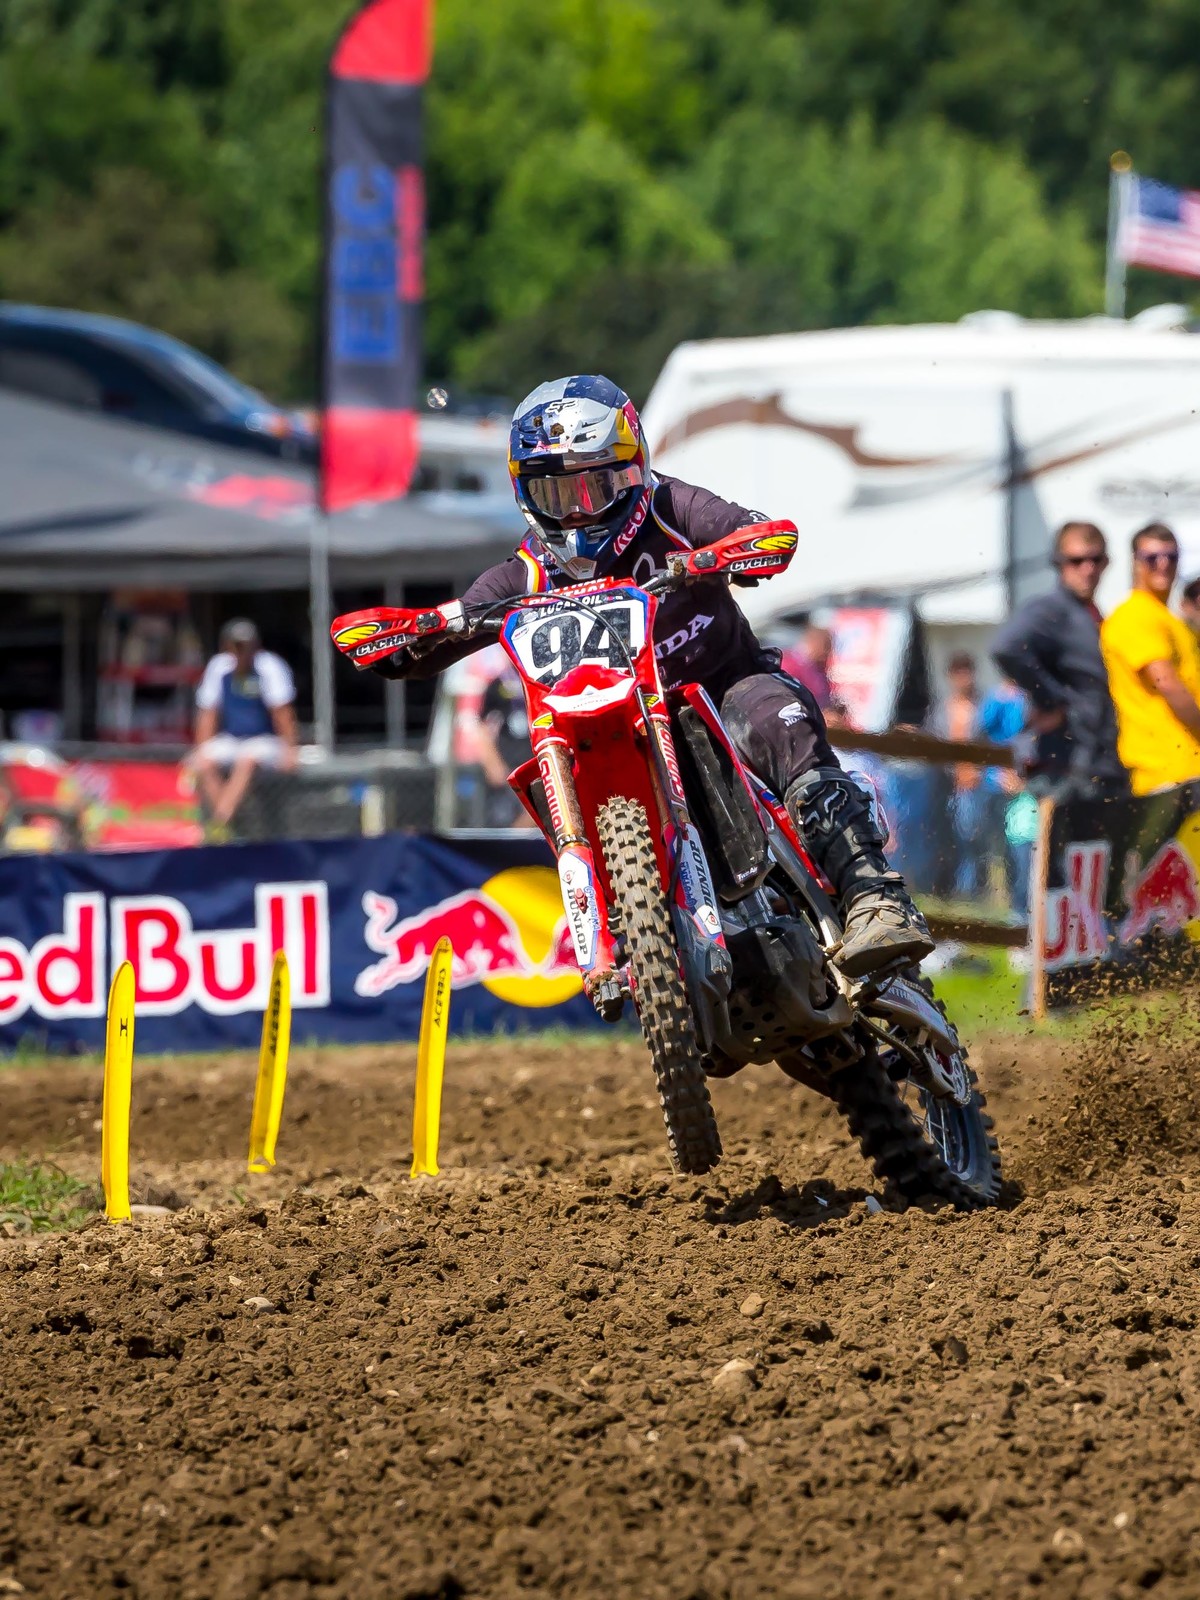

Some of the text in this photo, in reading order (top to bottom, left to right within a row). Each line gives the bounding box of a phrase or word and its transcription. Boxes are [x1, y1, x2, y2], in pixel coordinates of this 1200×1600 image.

[730, 554, 782, 572] CYCRA
[582, 595, 602, 605] OIL
[356, 633, 406, 656] CYCRA
[531, 607, 638, 687] 94
[689, 839, 715, 908] DUNLOP
[120, 889, 320, 1007] Bull
[566, 888, 589, 955] DUNLOP
